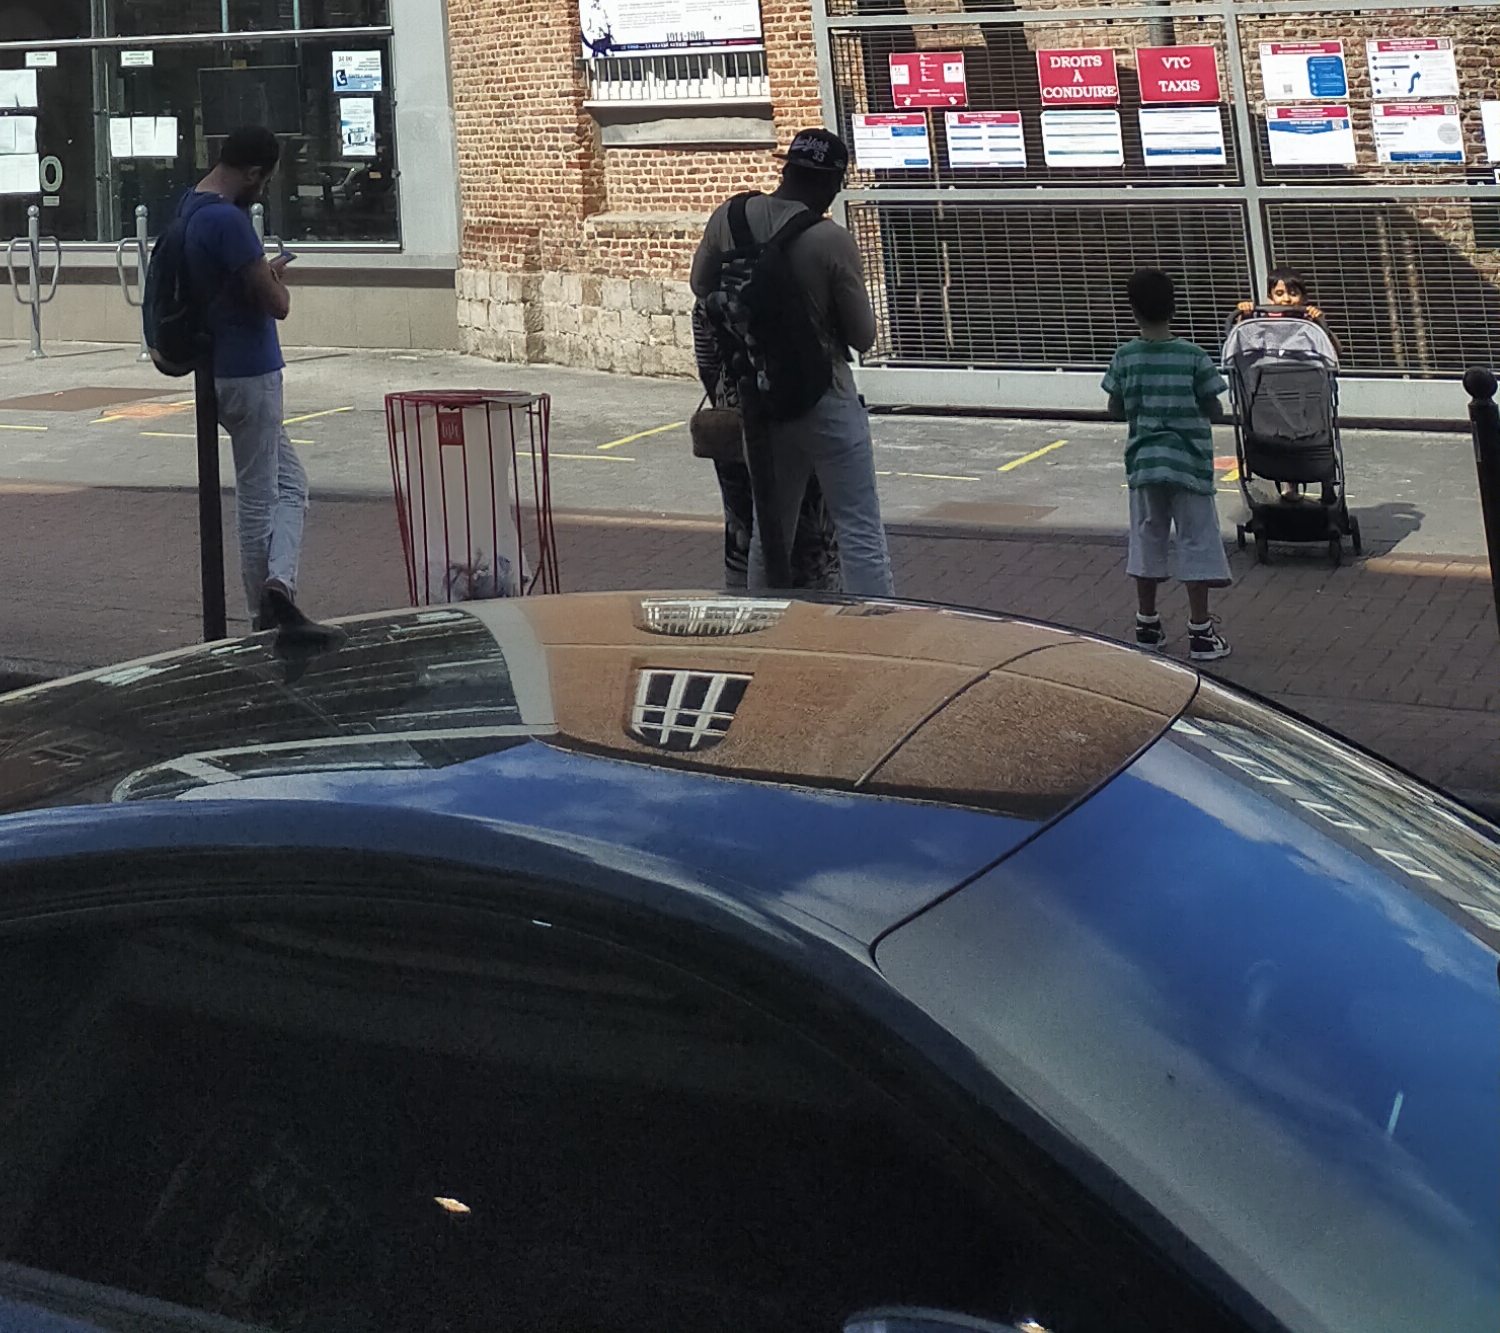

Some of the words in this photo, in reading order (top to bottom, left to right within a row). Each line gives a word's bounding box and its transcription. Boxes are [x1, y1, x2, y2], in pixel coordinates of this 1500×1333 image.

[1050, 55, 1103, 68] DROITS
[1161, 57, 1191, 69] VTC
[1043, 85, 1117, 98] CONDUIRE
[1158, 80, 1200, 92] TAXIS
